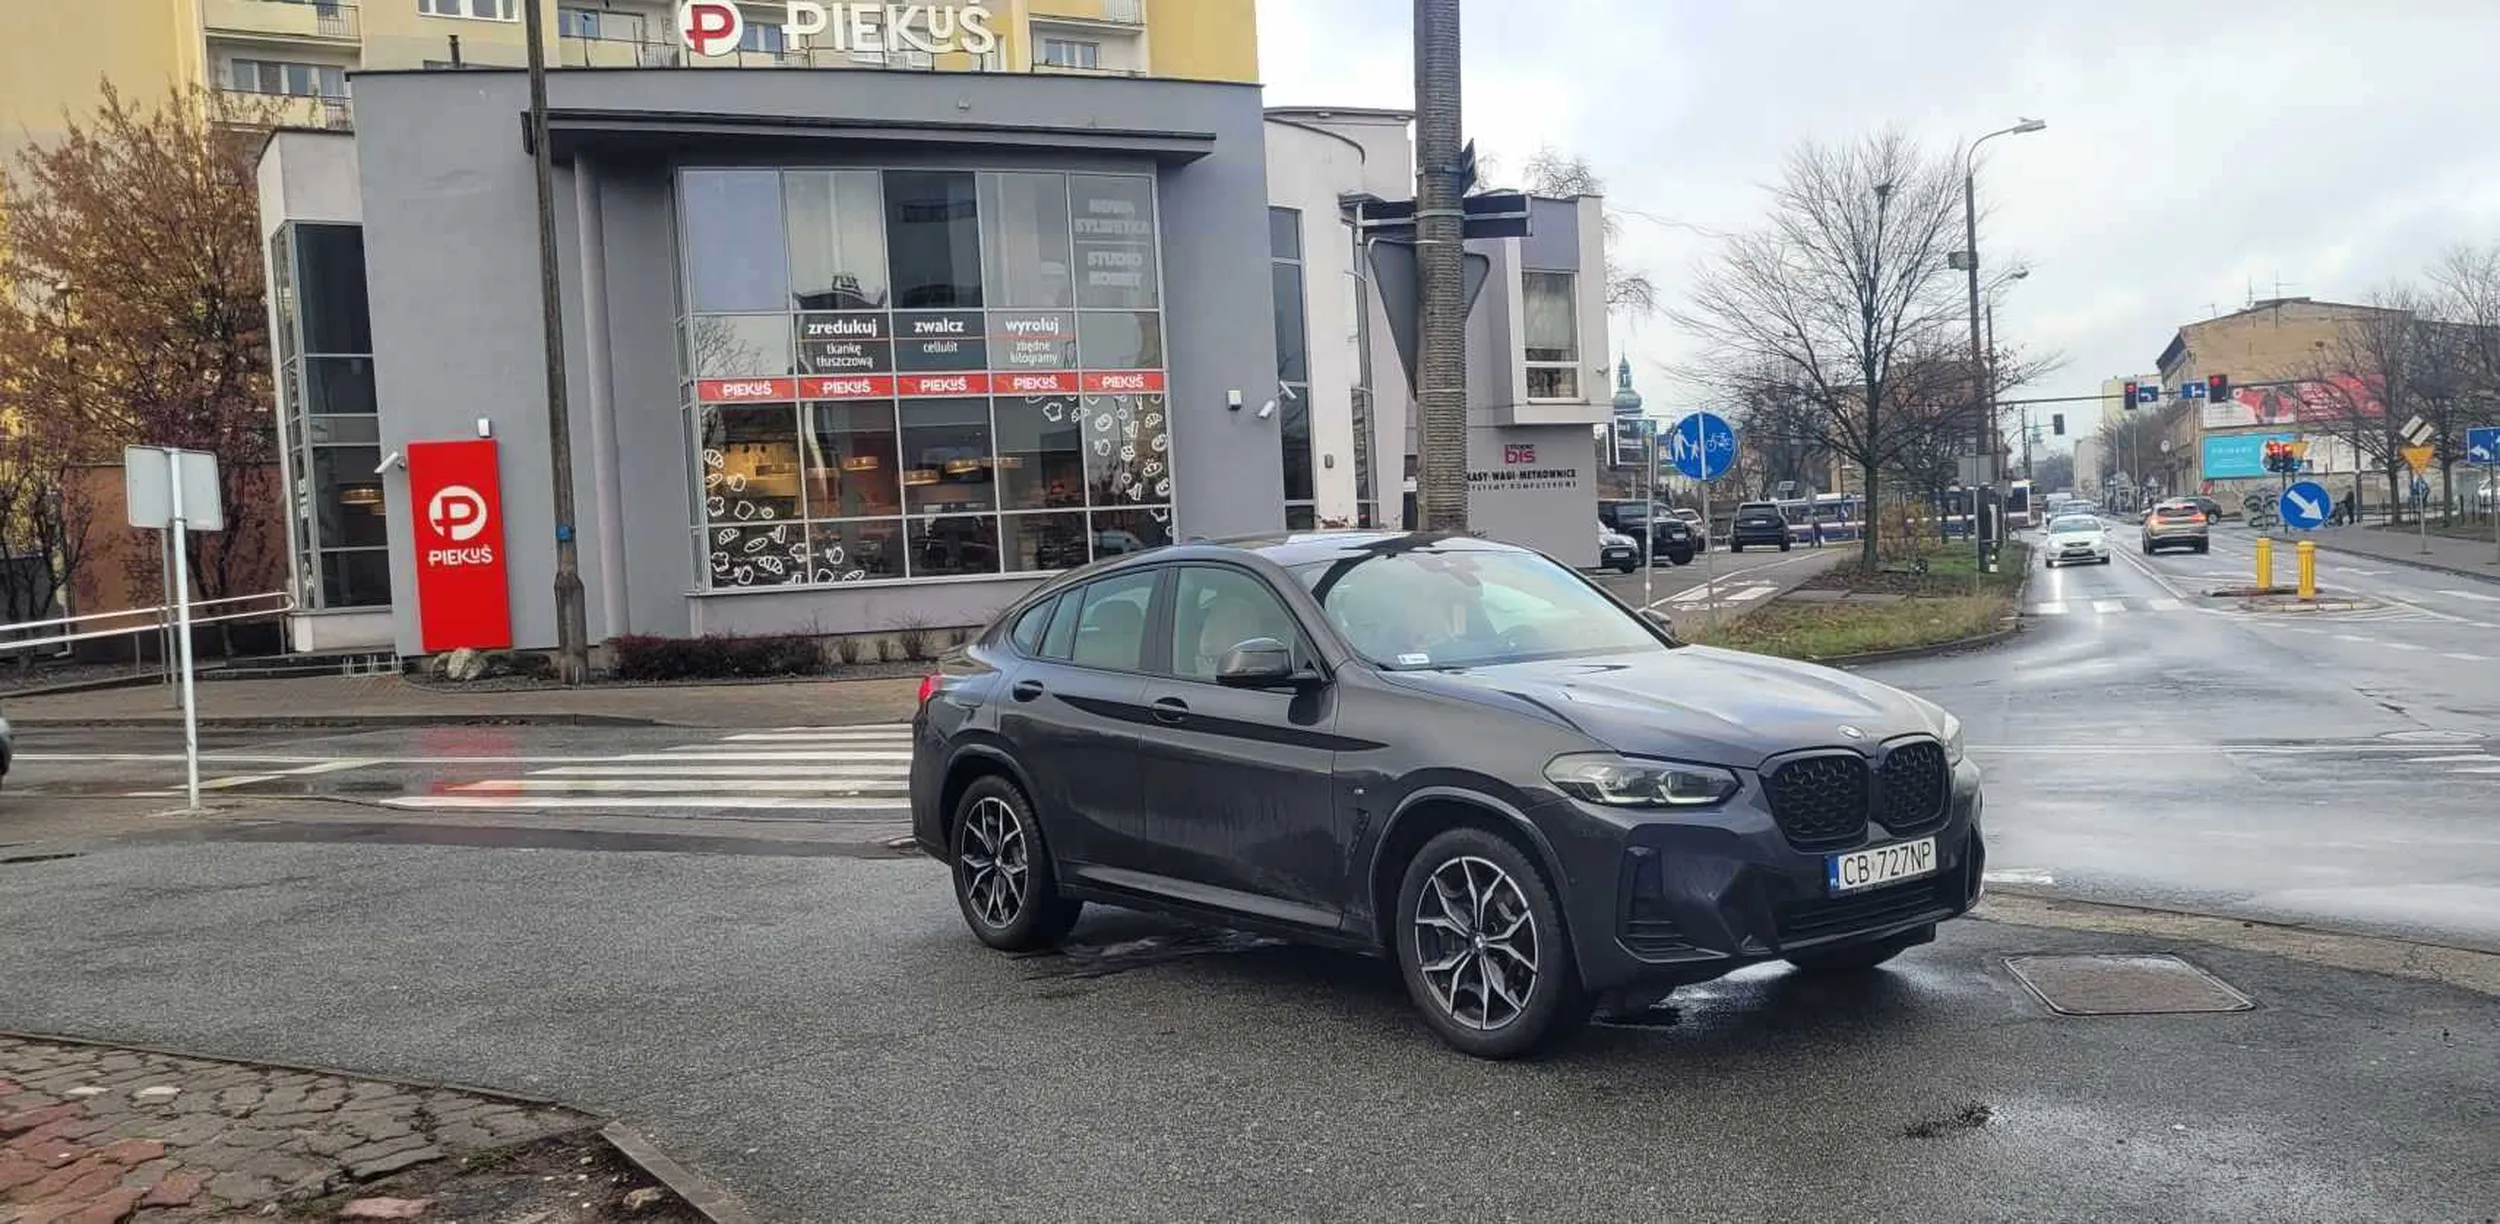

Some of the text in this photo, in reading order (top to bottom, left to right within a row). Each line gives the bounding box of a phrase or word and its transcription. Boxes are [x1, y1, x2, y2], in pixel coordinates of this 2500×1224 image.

[808, 318, 877, 338] zredukuj
[914, 317, 964, 334] zwalcz
[1005, 316, 1059, 336] wyroluj
[722, 381, 773, 397] PIEKUŚ
[822, 380, 872, 394] PIEKUŚ
[920, 377, 967, 393] PIEKUŚ
[1013, 375, 1058, 390] PIEKUŚ
[1102, 374, 1145, 389] PIEKUŚ
[428, 545, 494, 566] PIEKUŚ
[1843, 841, 1932, 886] CB 727NP
